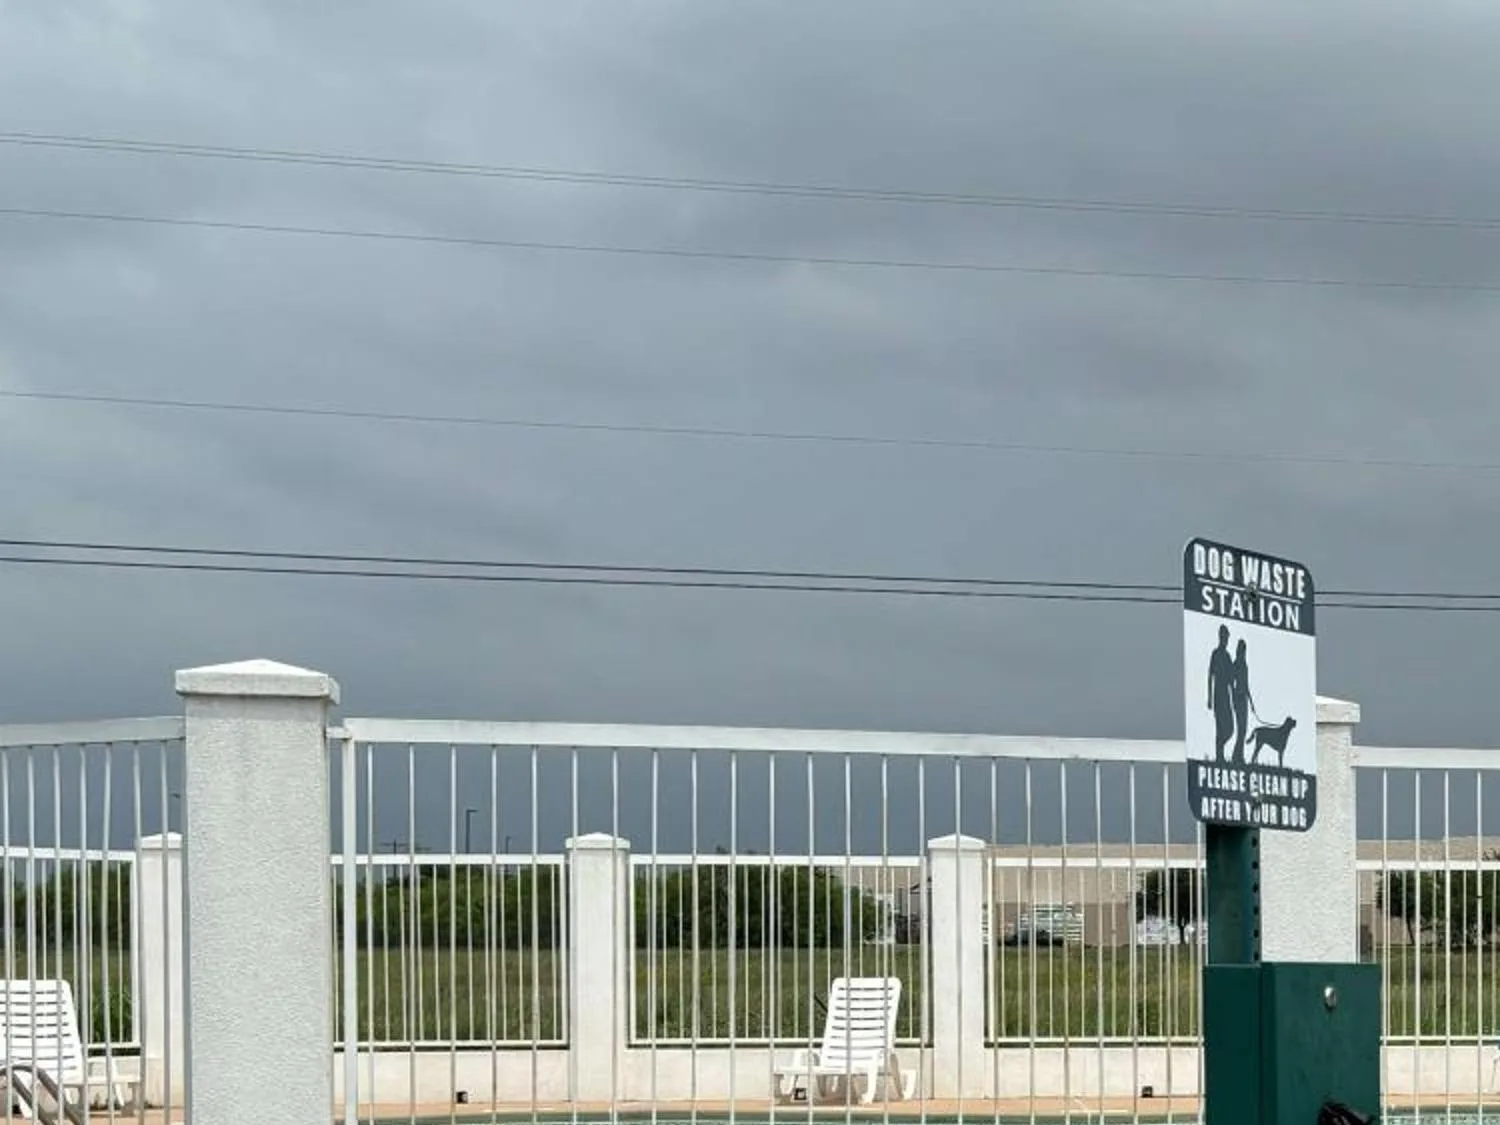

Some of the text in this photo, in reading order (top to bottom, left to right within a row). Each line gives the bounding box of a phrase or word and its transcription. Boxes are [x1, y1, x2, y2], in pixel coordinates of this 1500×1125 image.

[1193, 543, 1306, 599] DOG WASTE
[1198, 766, 1308, 799] PLEASE CLEAN UP
[1201, 797, 1308, 829] AFTER YOUR DOG
